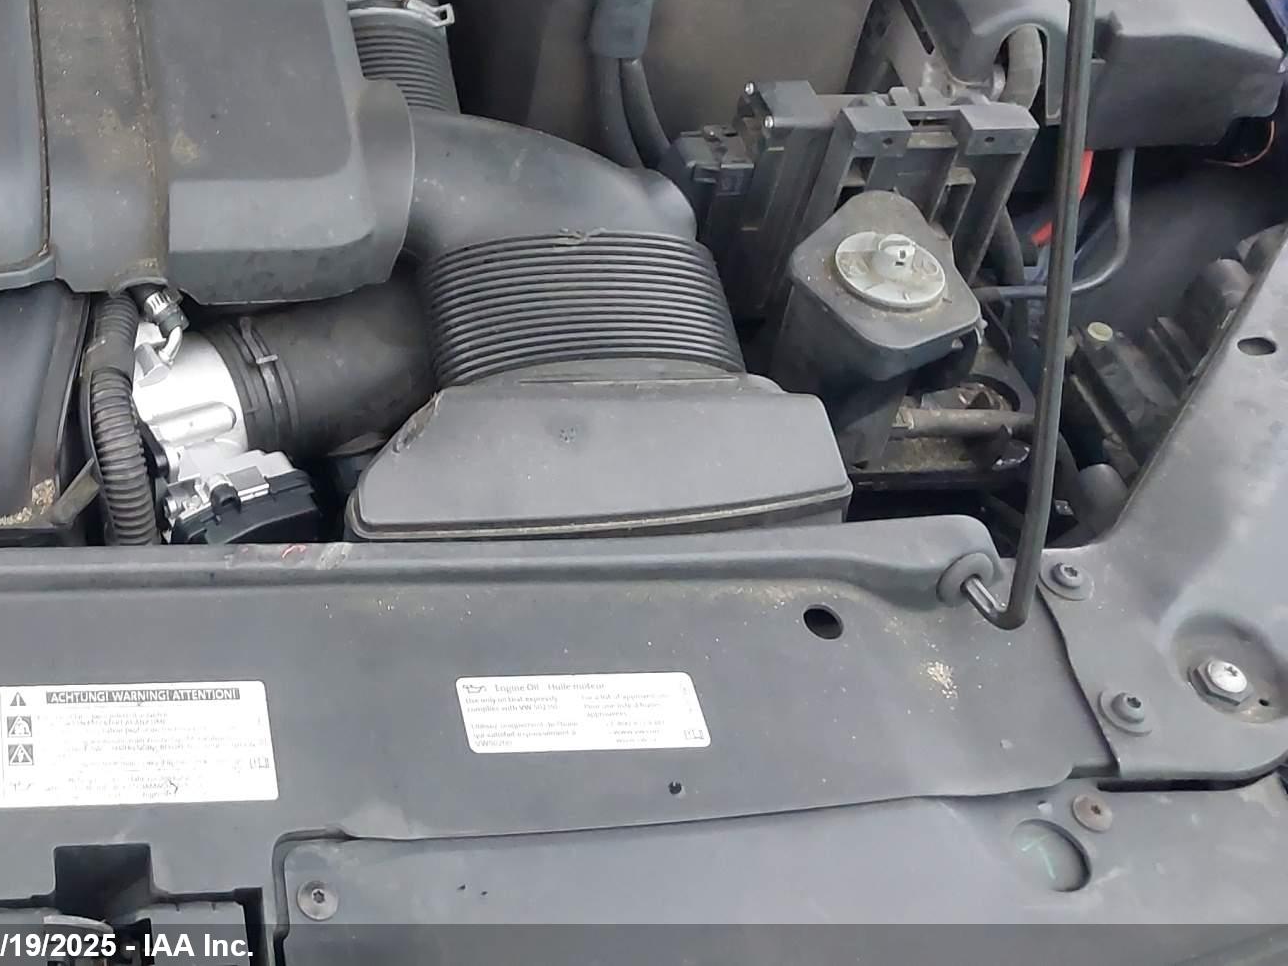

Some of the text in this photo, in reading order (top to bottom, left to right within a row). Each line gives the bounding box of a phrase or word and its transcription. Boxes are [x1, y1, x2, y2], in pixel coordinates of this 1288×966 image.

[49, 688, 238, 704] ACHTUNG! WARNING! ATTENTION!
